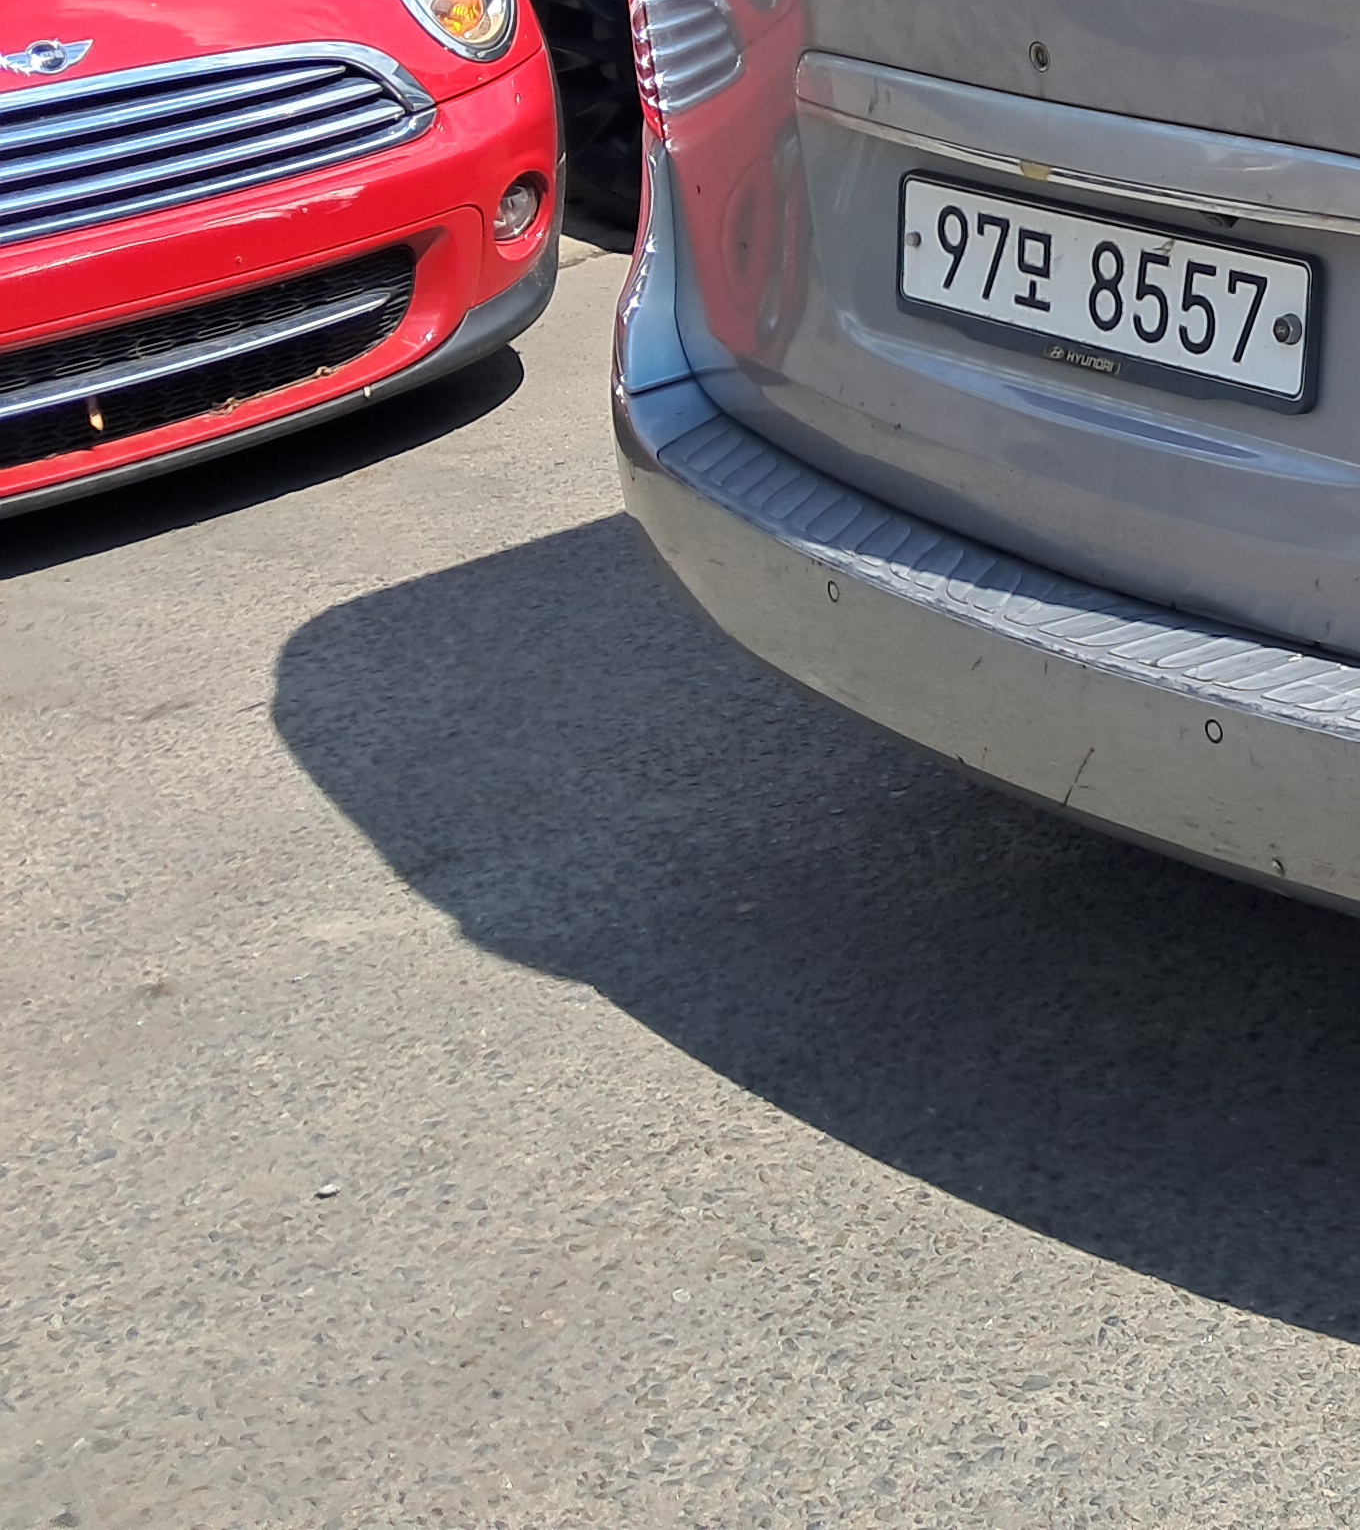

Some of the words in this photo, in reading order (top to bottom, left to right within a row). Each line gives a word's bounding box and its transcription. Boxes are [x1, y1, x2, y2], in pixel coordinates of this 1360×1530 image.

[935, 204, 1053, 314] 97모
[1087, 239, 1269, 365] 8557
[1065, 349, 1116, 373] HYUNDAI
